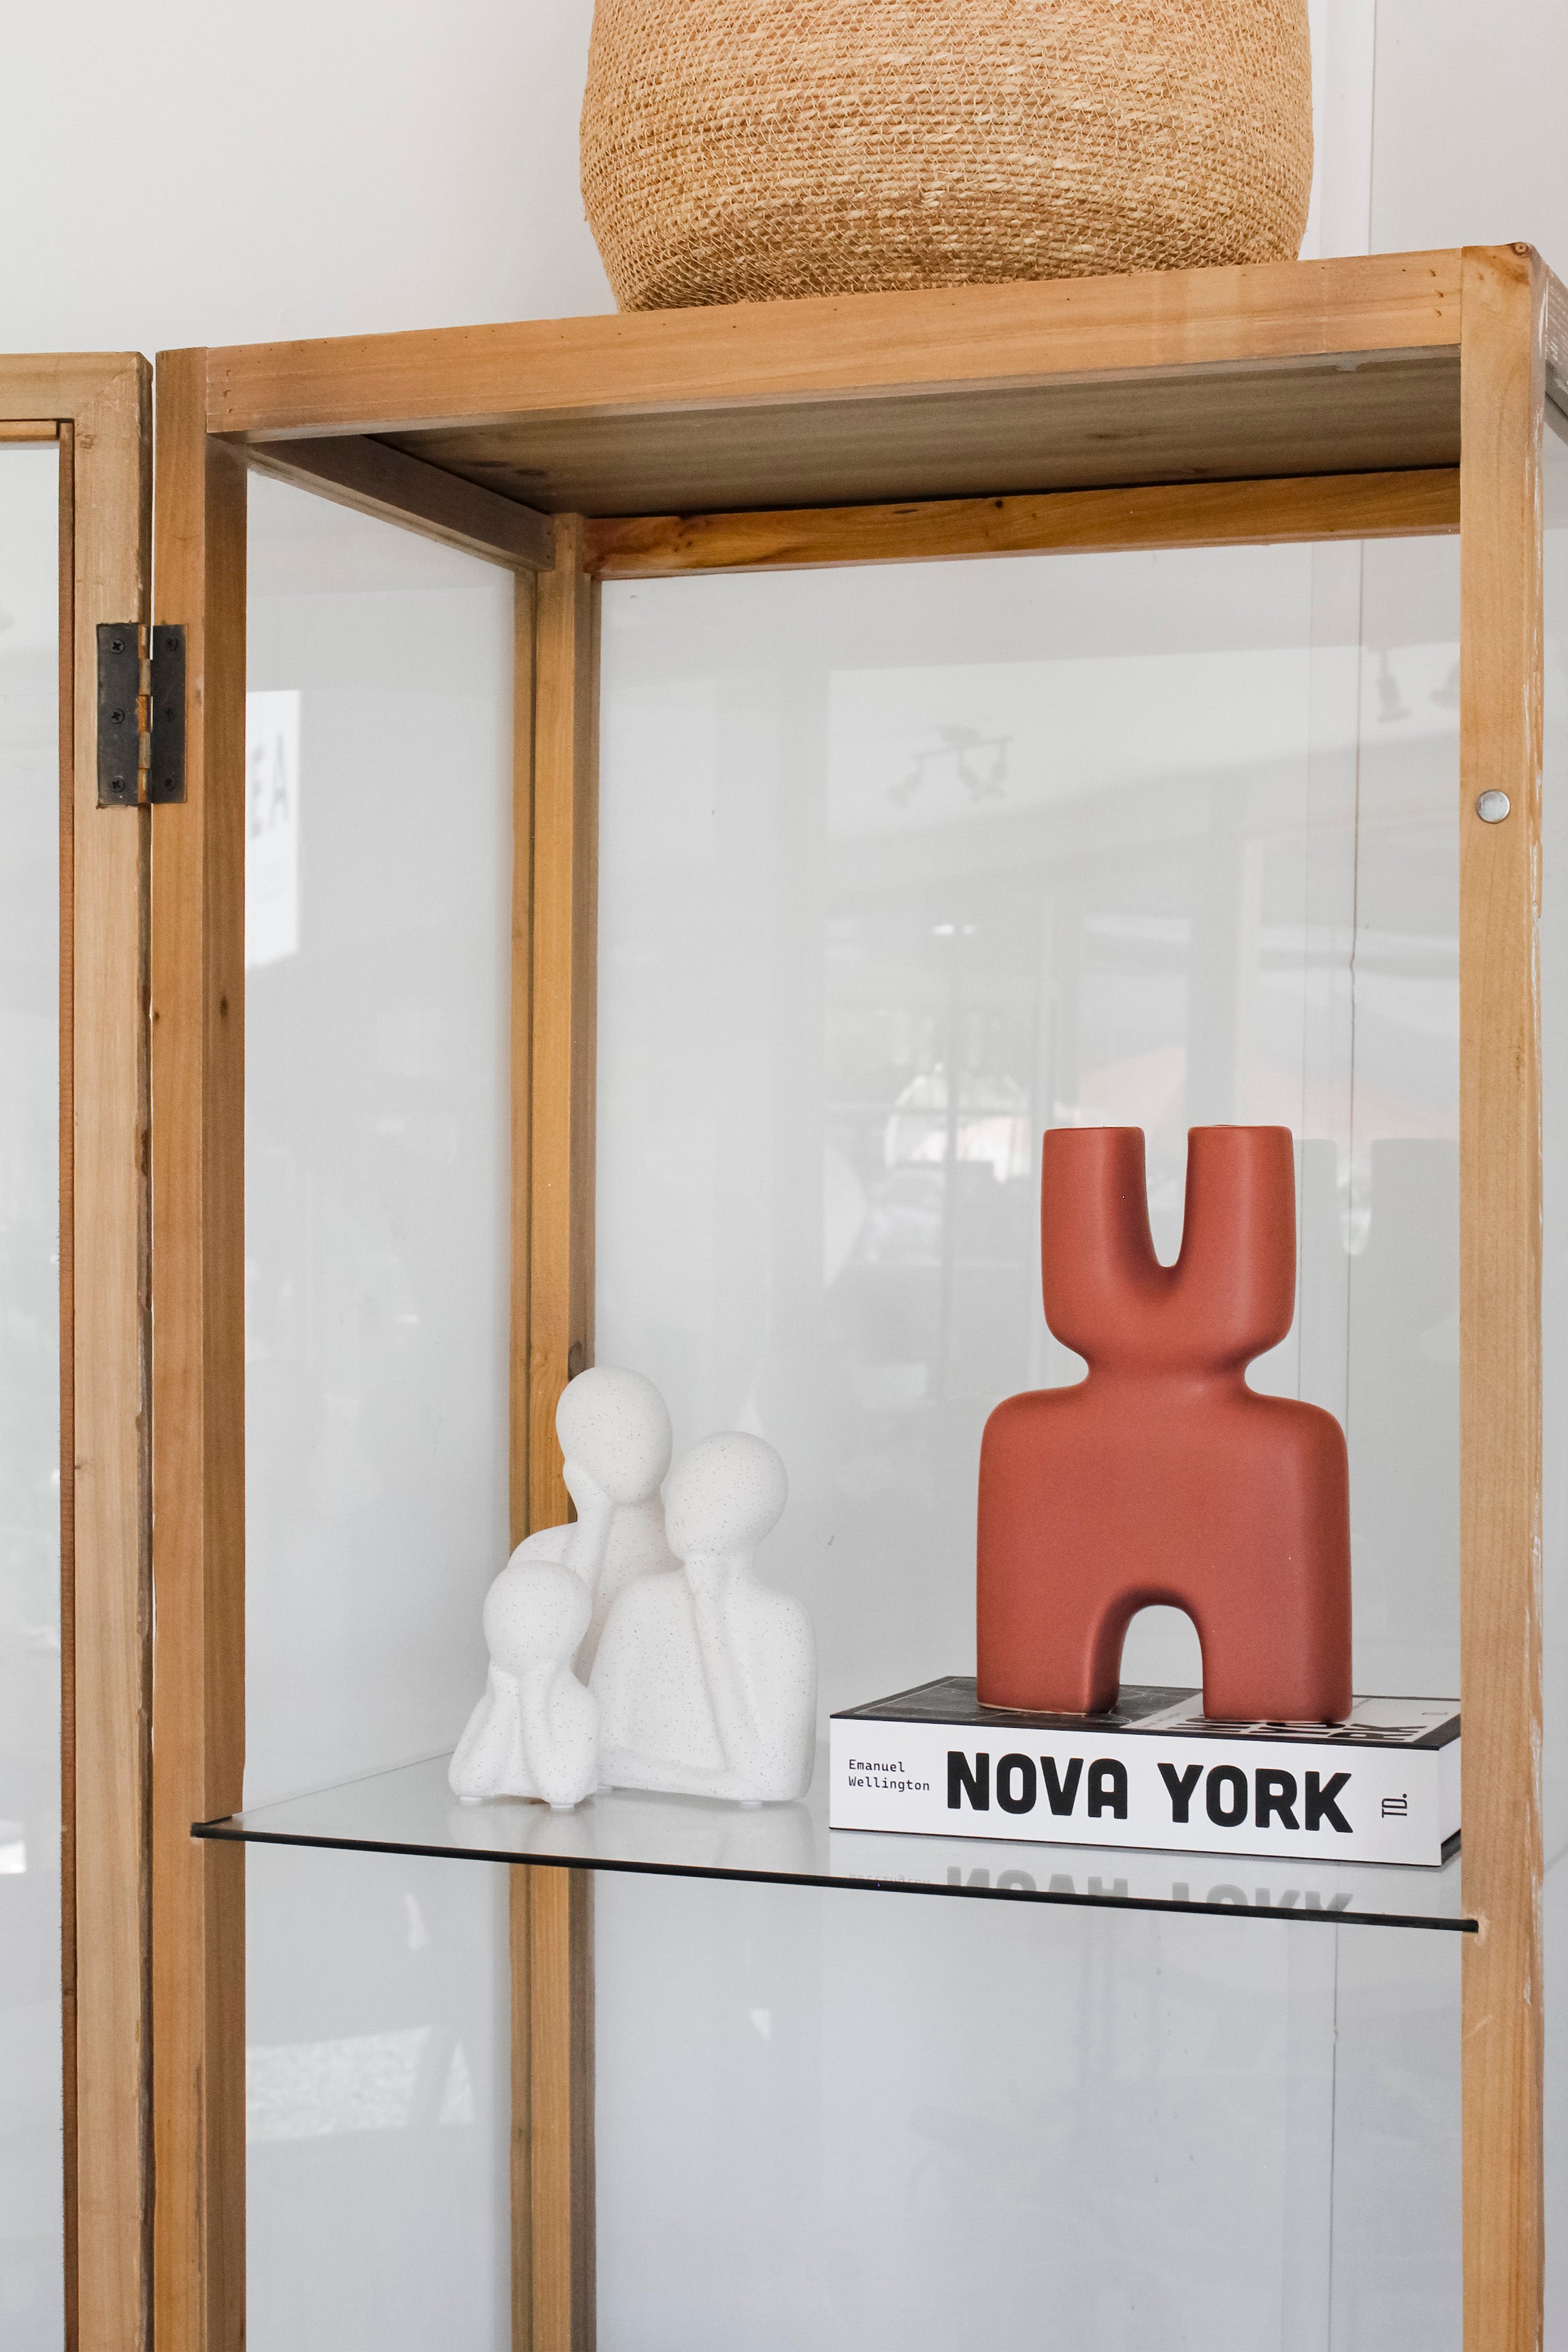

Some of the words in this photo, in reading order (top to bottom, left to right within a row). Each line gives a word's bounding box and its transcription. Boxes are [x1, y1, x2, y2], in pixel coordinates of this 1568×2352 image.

[849, 1759, 905, 1773] Emanuel
[849, 1776, 930, 1793] Wellington
[947, 1750, 1128, 1820] NOVA
[1157, 1763, 1354, 1833] YORK
